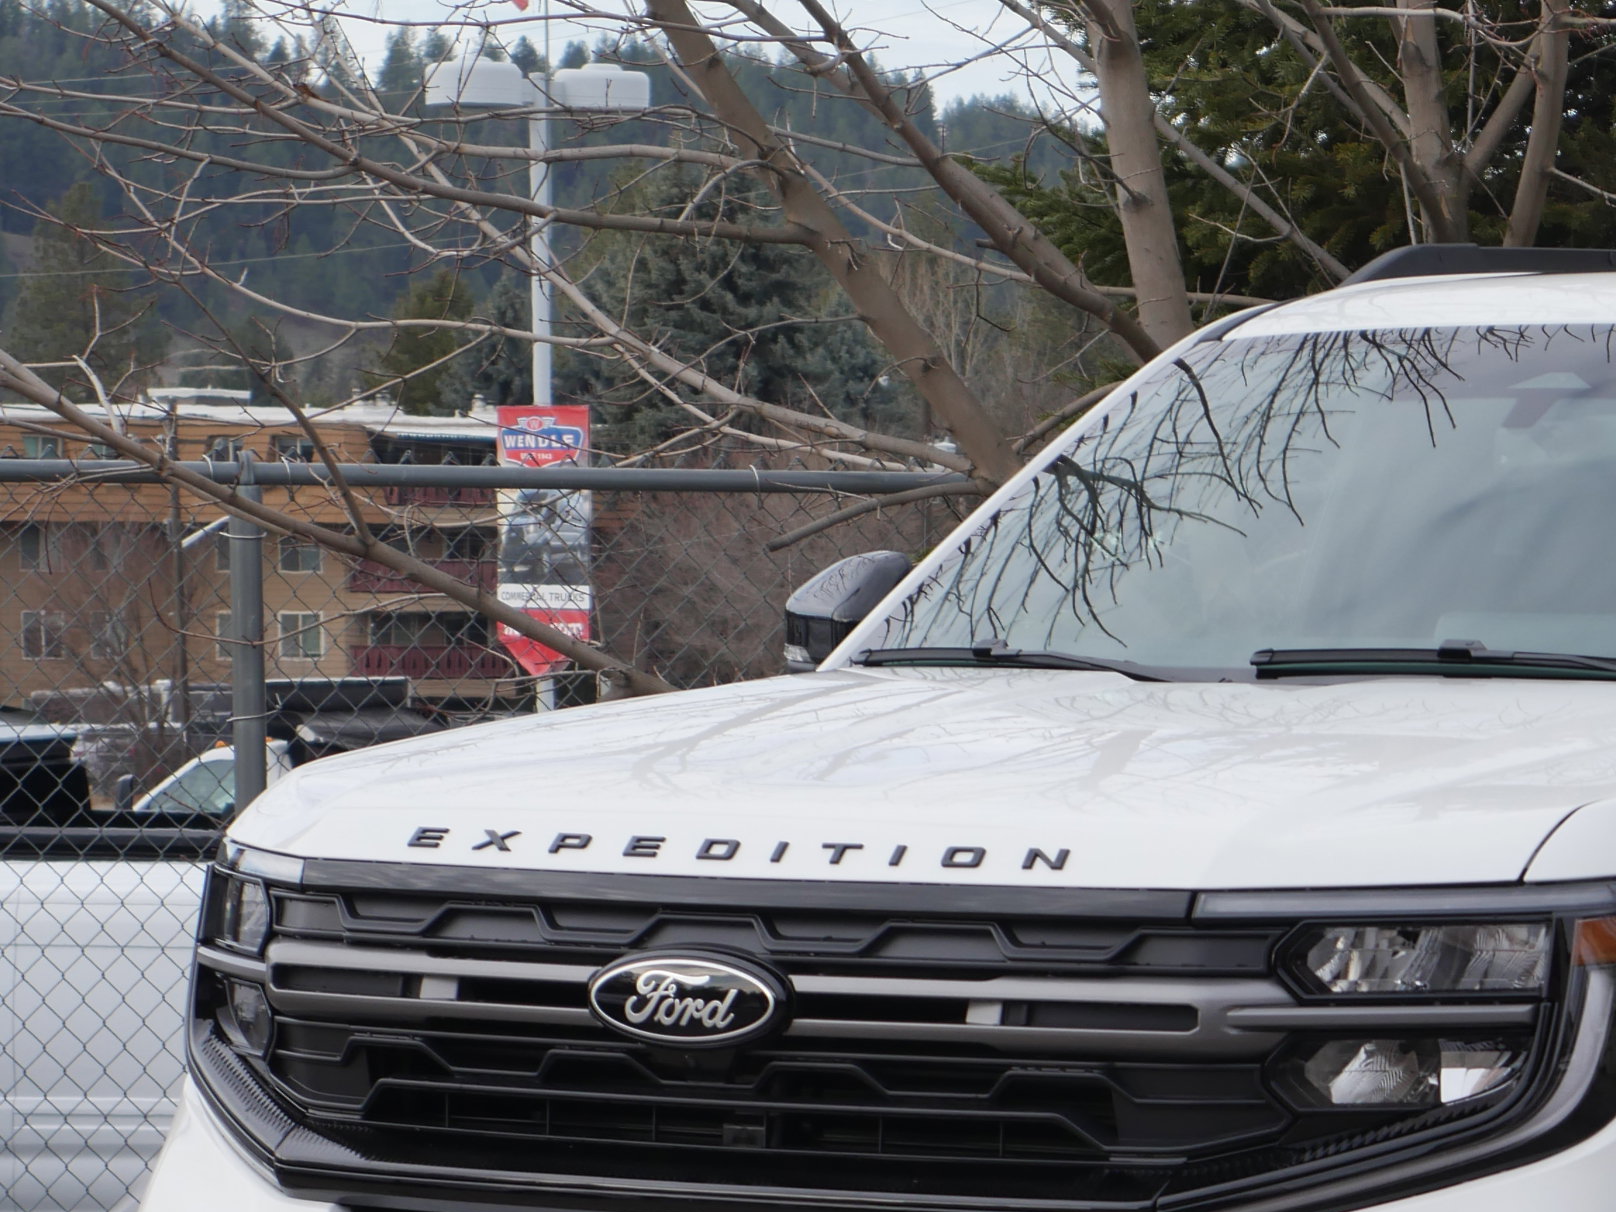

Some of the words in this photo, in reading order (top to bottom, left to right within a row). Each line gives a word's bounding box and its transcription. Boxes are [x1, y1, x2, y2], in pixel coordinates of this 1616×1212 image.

[504, 434, 574, 448] WENDLE
[501, 591, 546, 601] COMMERIAL
[408, 826, 1071, 871] EXPEDITION
[624, 970, 738, 1029] Ford
